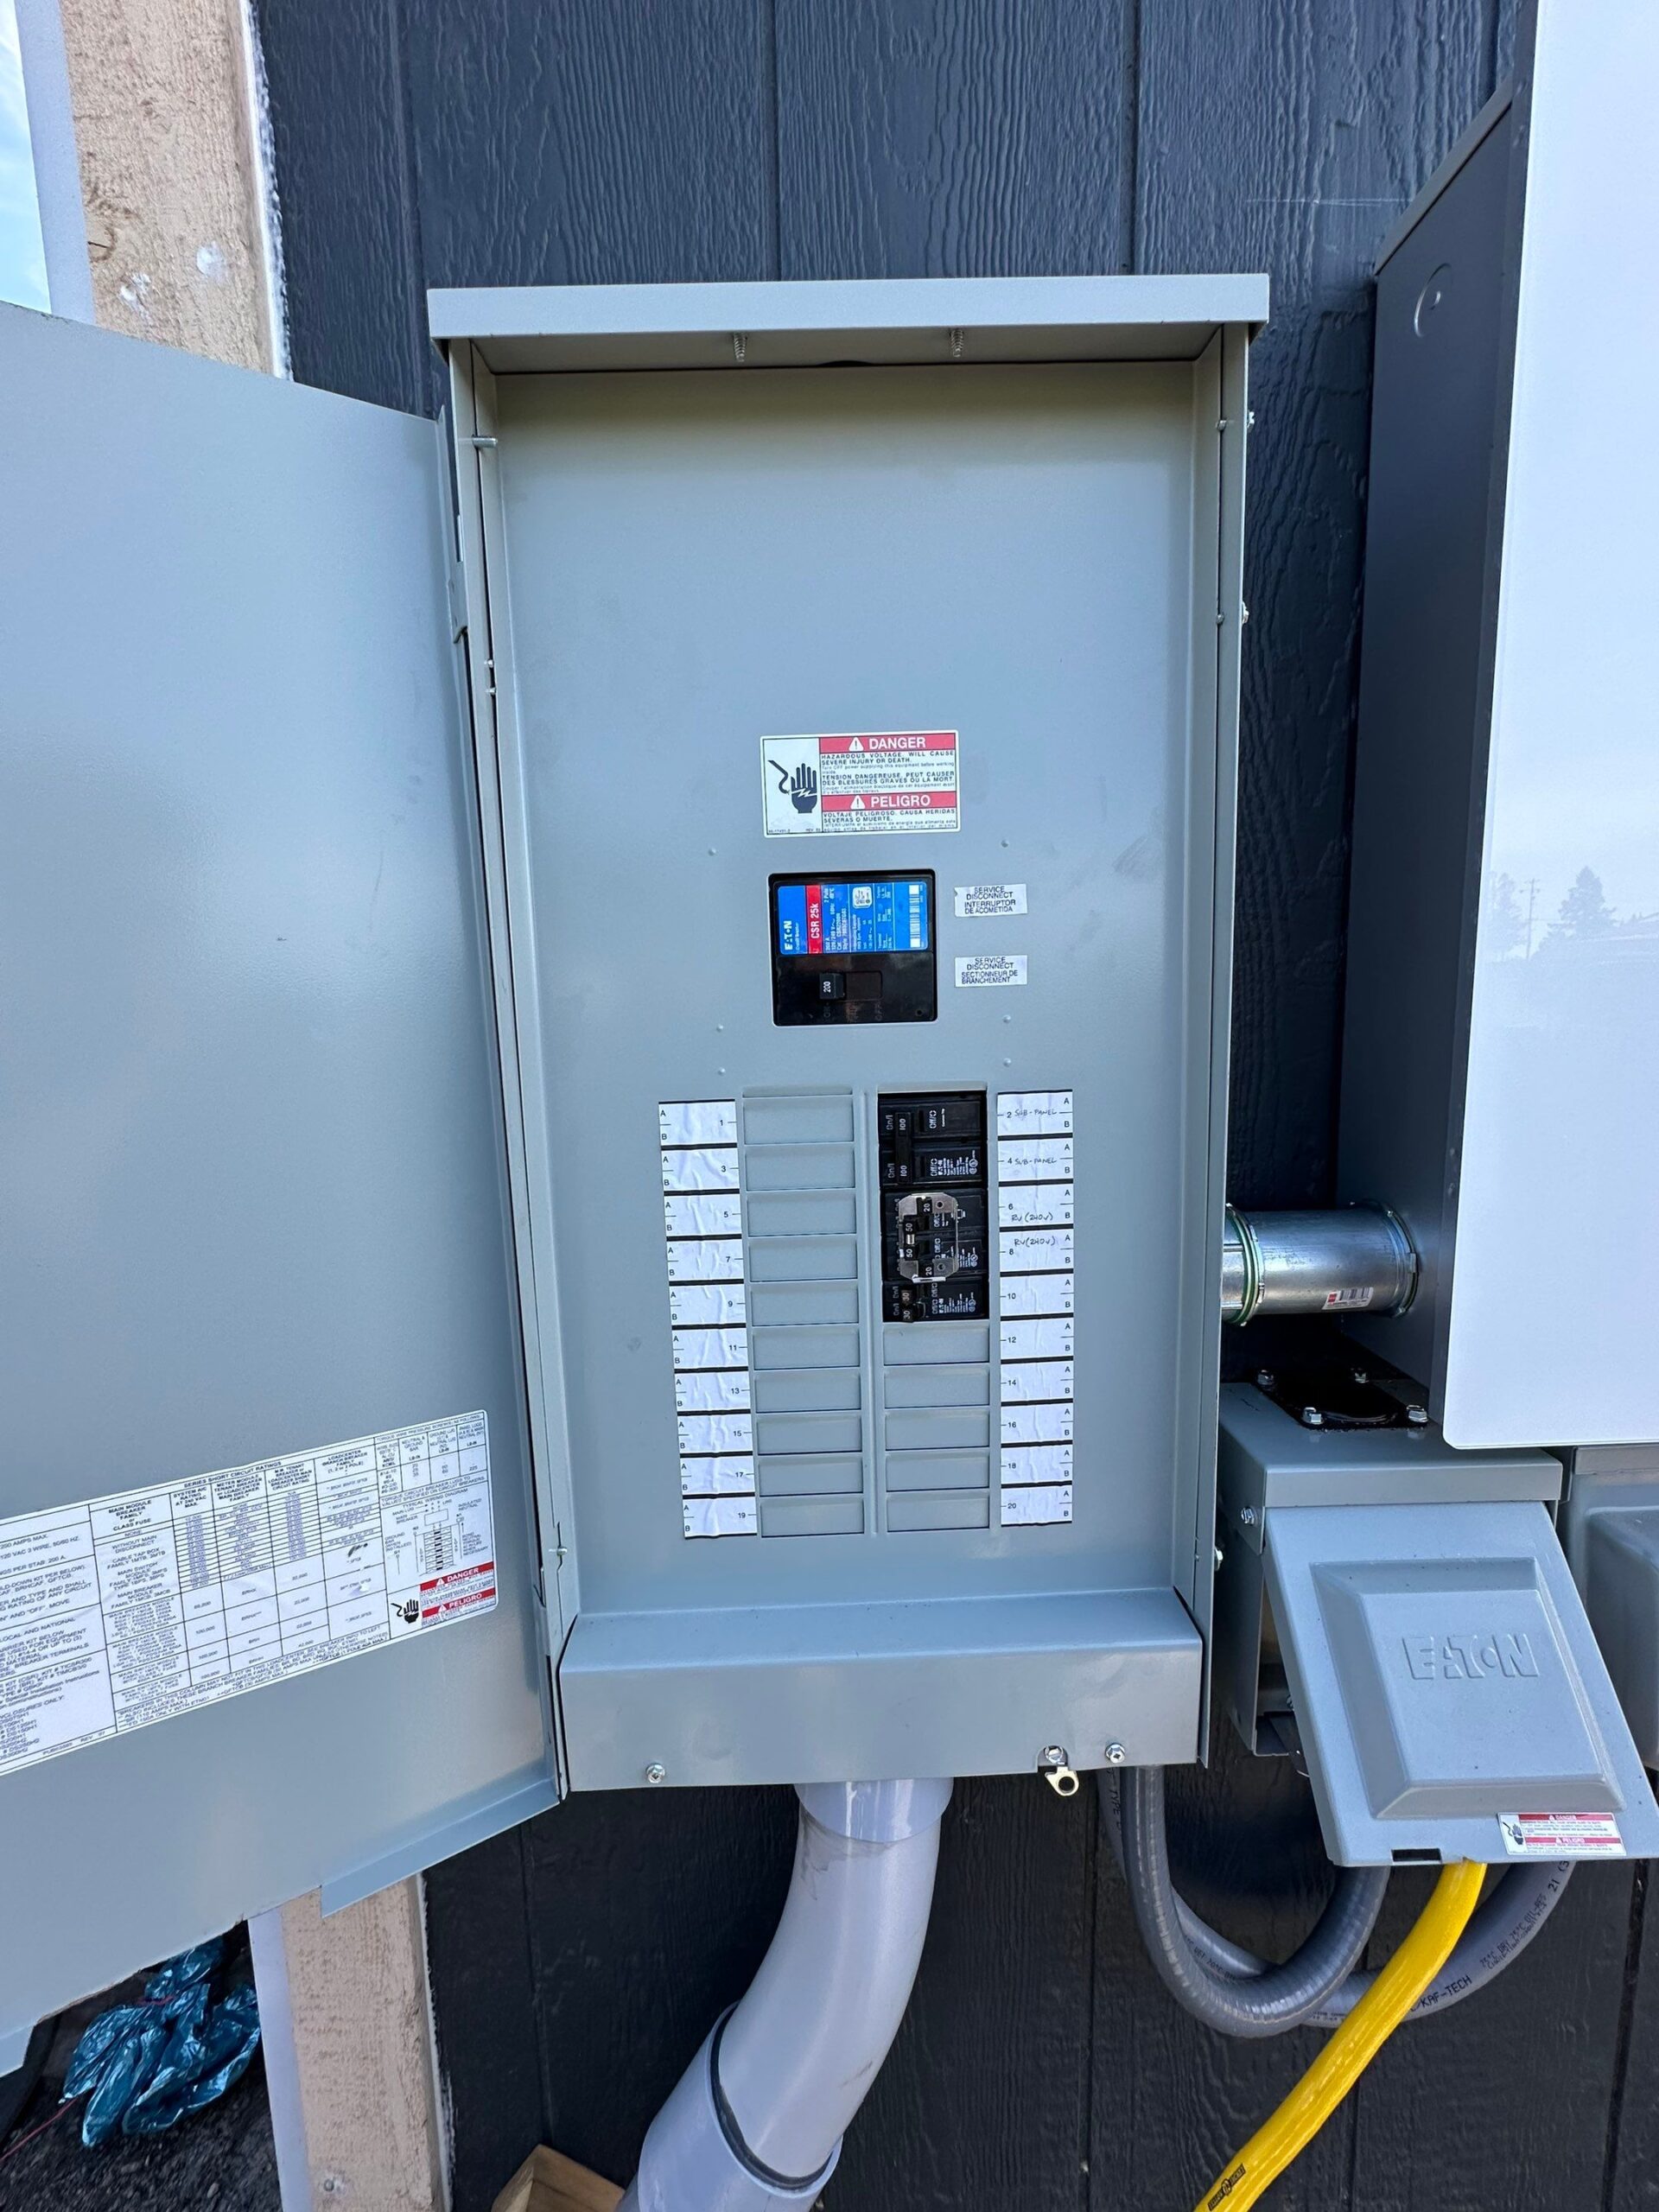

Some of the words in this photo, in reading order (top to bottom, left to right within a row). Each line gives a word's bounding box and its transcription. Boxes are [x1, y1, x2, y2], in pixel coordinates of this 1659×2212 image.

[869, 737, 926, 750] DANGER
[871, 795, 931, 808] PELIGRO
[974, 886, 1005, 894] SERVICE
[966, 892, 1014, 900] DISCONNECT
[964, 899, 1016, 908] INTERRUPTOR
[810, 903, 819, 918] 25k
[976, 906, 1014, 914] ACOMETIDA
[783, 920, 793, 950] EATON
[810, 921, 820, 939] CSR
[966, 963, 1014, 971] DISCONNECT
[962, 976, 1010, 985] BRANCHEMENT
[924, 1204, 931, 1212] 20
[906, 1224, 912, 1232] 50
[906, 1249, 912, 1258] 50
[925, 1267, 932, 1275] 20
[903, 1311, 911, 1319] 30
[184, 1478, 207, 1488] SERIES
[208, 1474, 229, 1483] SHORT
[230, 1468, 254, 1478] CIRCUIT
[256, 1462, 282, 1471] RATINGS
[126, 1500, 152, 1510] MODULE
[116, 1506, 146, 1516] BREAKER
[112, 1539, 140, 1549] WITHOUT
[448, 1567, 479, 1582] DANGER
[65, 1583, 92, 1594] CIRCUIT
[66, 1580, 86, 1588] SHALL
[449, 1593, 482, 1609] PELIGRO
[41, 1618, 76, 1627] NATIONAL
[50, 1643, 89, 1657] TERMINALS
[1402, 1633, 1540, 1680] EATON
